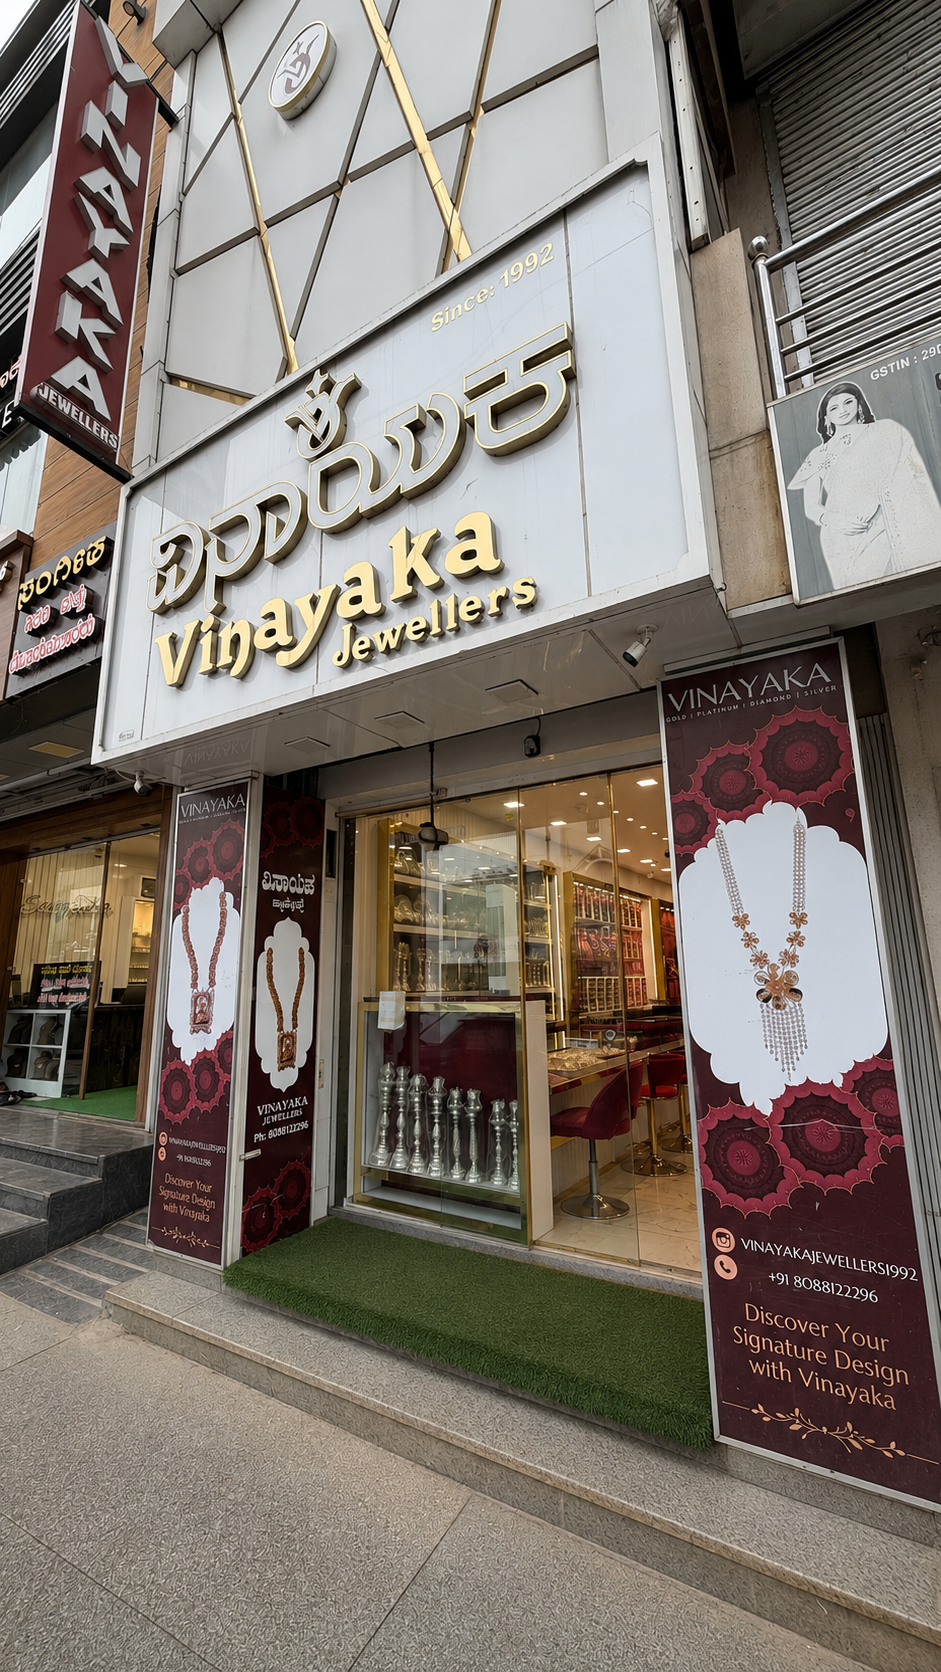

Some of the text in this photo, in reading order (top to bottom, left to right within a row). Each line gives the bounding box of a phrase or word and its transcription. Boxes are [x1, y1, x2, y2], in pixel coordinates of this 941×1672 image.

[50, 16, 149, 422] VINAYAKA
[430, 242, 554, 332] Since: 1992
[870, 355, 911, 382] GSTIN
[38, 382, 119, 450] JEWELLERS
[154, 511, 505, 688] Vinayaka
[332, 575, 538, 668] Jewellers
[666, 684, 838, 723] GOLD PLATINUM DIAMOND SILVER
[667, 662, 832, 712] VINAYAKA
[180, 793, 246, 818] VINAYAKA
[257, 1095, 309, 1116] VINAYAKA
[262, 1108, 303, 1126] JEWELLERS
[253, 1131, 267, 1143] Ph:
[195, 1179, 213, 1193] Your
[741, 1237, 919, 1282] VINAYAKAJEWELLERS1992
[768, 1272, 879, 1303] +91 8088122296
[745, 1302, 890, 1352] Discover Your
[733, 1325, 910, 1387] Signature Design
[749, 1359, 897, 1410] with Vinayaka
